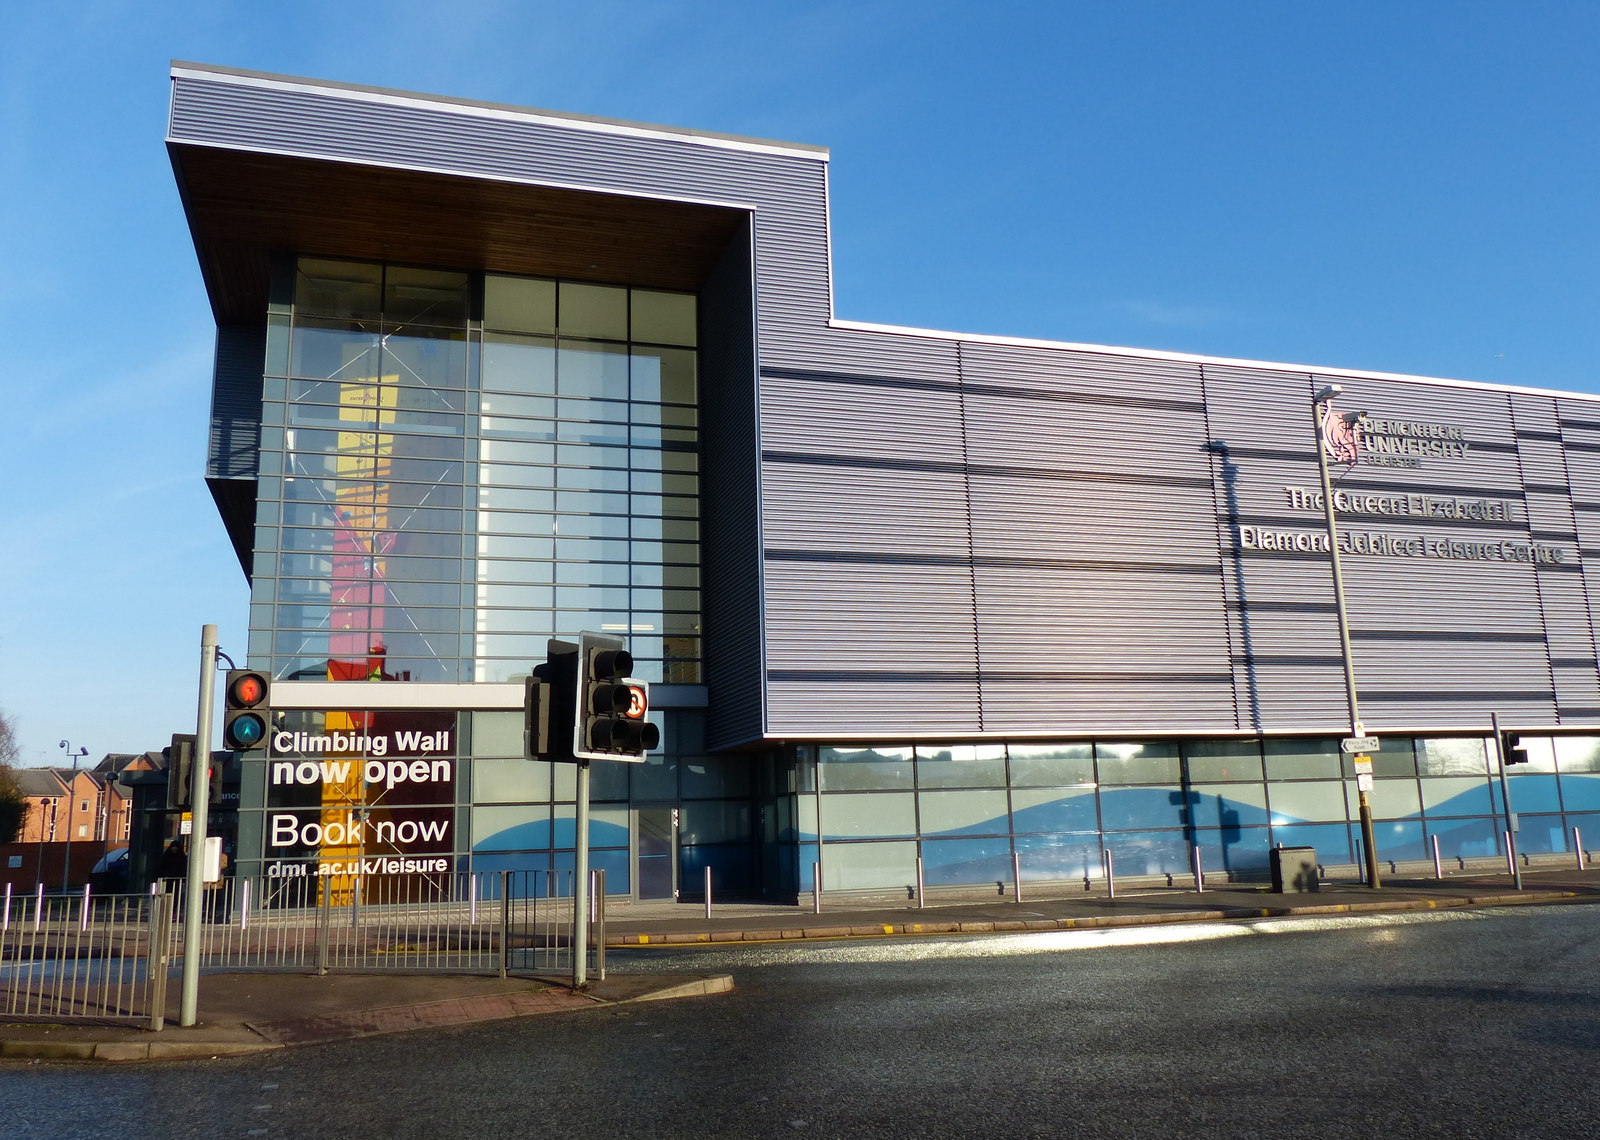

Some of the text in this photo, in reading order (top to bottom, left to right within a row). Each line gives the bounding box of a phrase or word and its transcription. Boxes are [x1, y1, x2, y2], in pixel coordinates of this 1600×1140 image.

[1365, 435, 1469, 459] UNIVERSITY
[1333, 490, 1402, 514] Queen
[1407, 494, 1499, 520] Elizabeth
[1344, 532, 1418, 556] Jubilee
[1423, 535, 1496, 560] Leisure
[1500, 540, 1565, 564] Centre
[274, 731, 449, 755] Climbing Wall
[273, 759, 451, 789] now open
[271, 813, 449, 847] Book now
